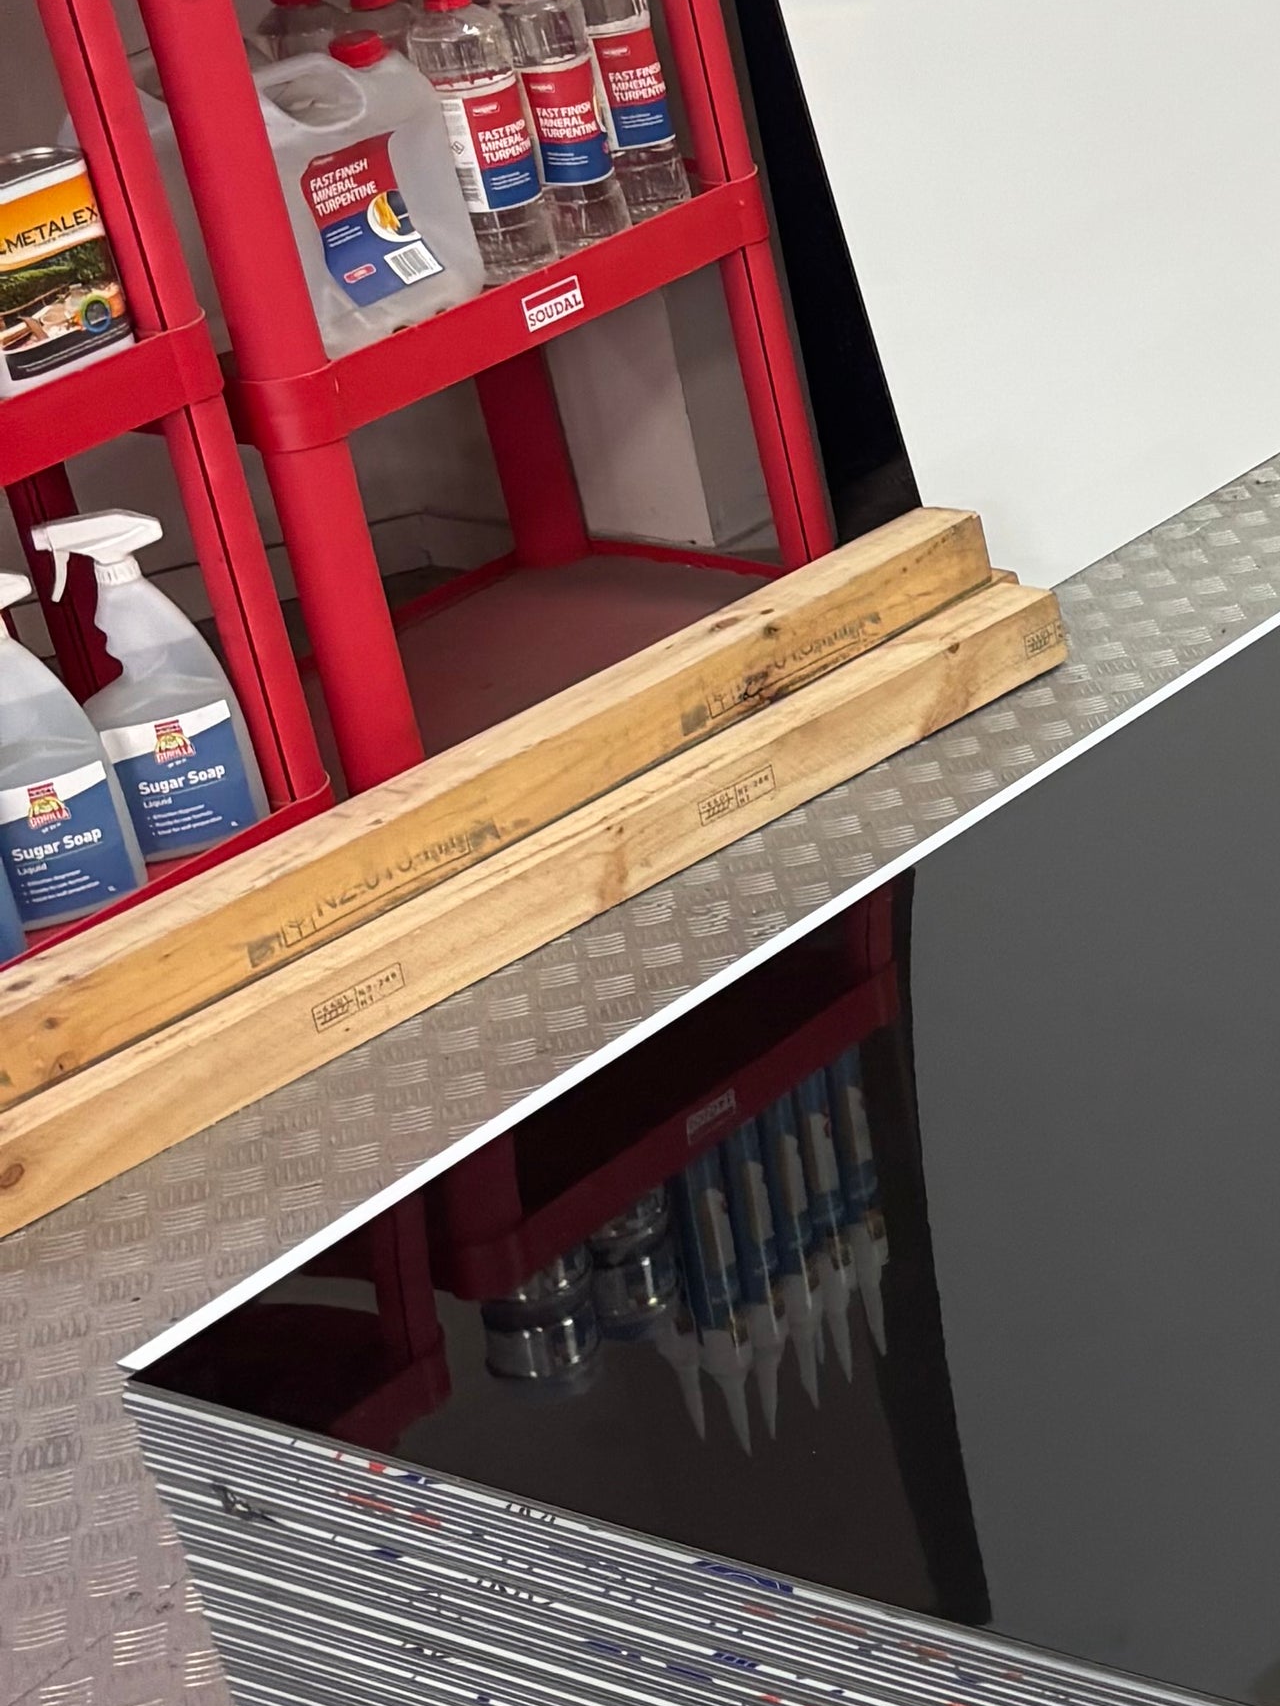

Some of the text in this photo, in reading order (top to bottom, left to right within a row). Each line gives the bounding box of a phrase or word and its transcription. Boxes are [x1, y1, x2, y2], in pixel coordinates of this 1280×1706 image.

[609, 71, 635, 83] FAST
[612, 77, 657, 92] MINERAL
[536, 107, 560, 119] FAST
[540, 116, 584, 130] MINERAL
[478, 127, 504, 142] FAST
[481, 134, 524, 153] MINERAL
[310, 158, 368, 191] FAST FINISH
[312, 177, 358, 204] MINERAL
[315, 181, 378, 217] TURPENTINE
[4, 204, 98, 253] METALEX
[528, 293, 582, 327] SOUDAL
[138, 764, 226, 796] Sugar Soap
[11, 828, 102, 863] Sugar Soap
